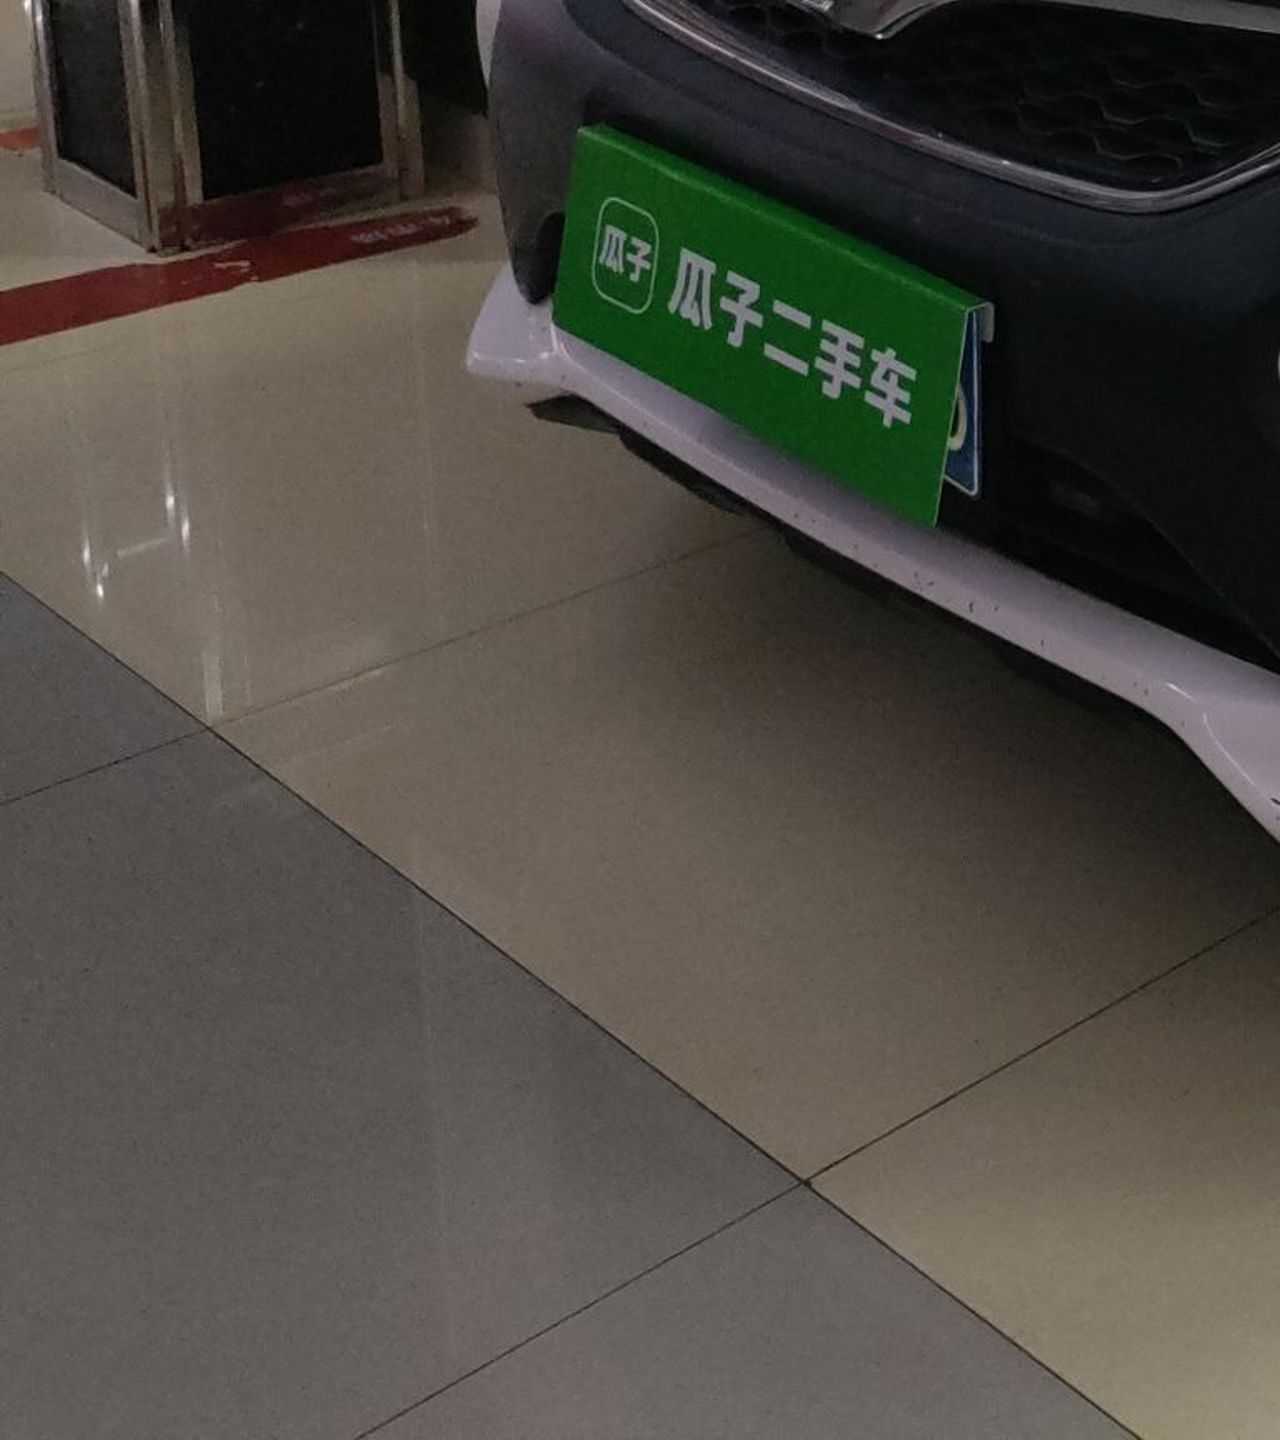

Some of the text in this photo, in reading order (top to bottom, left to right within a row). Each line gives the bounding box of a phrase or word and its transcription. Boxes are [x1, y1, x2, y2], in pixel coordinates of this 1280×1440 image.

[599, 223, 652, 283] 瓜子
[667, 247, 917, 428] 瓜子二手车
